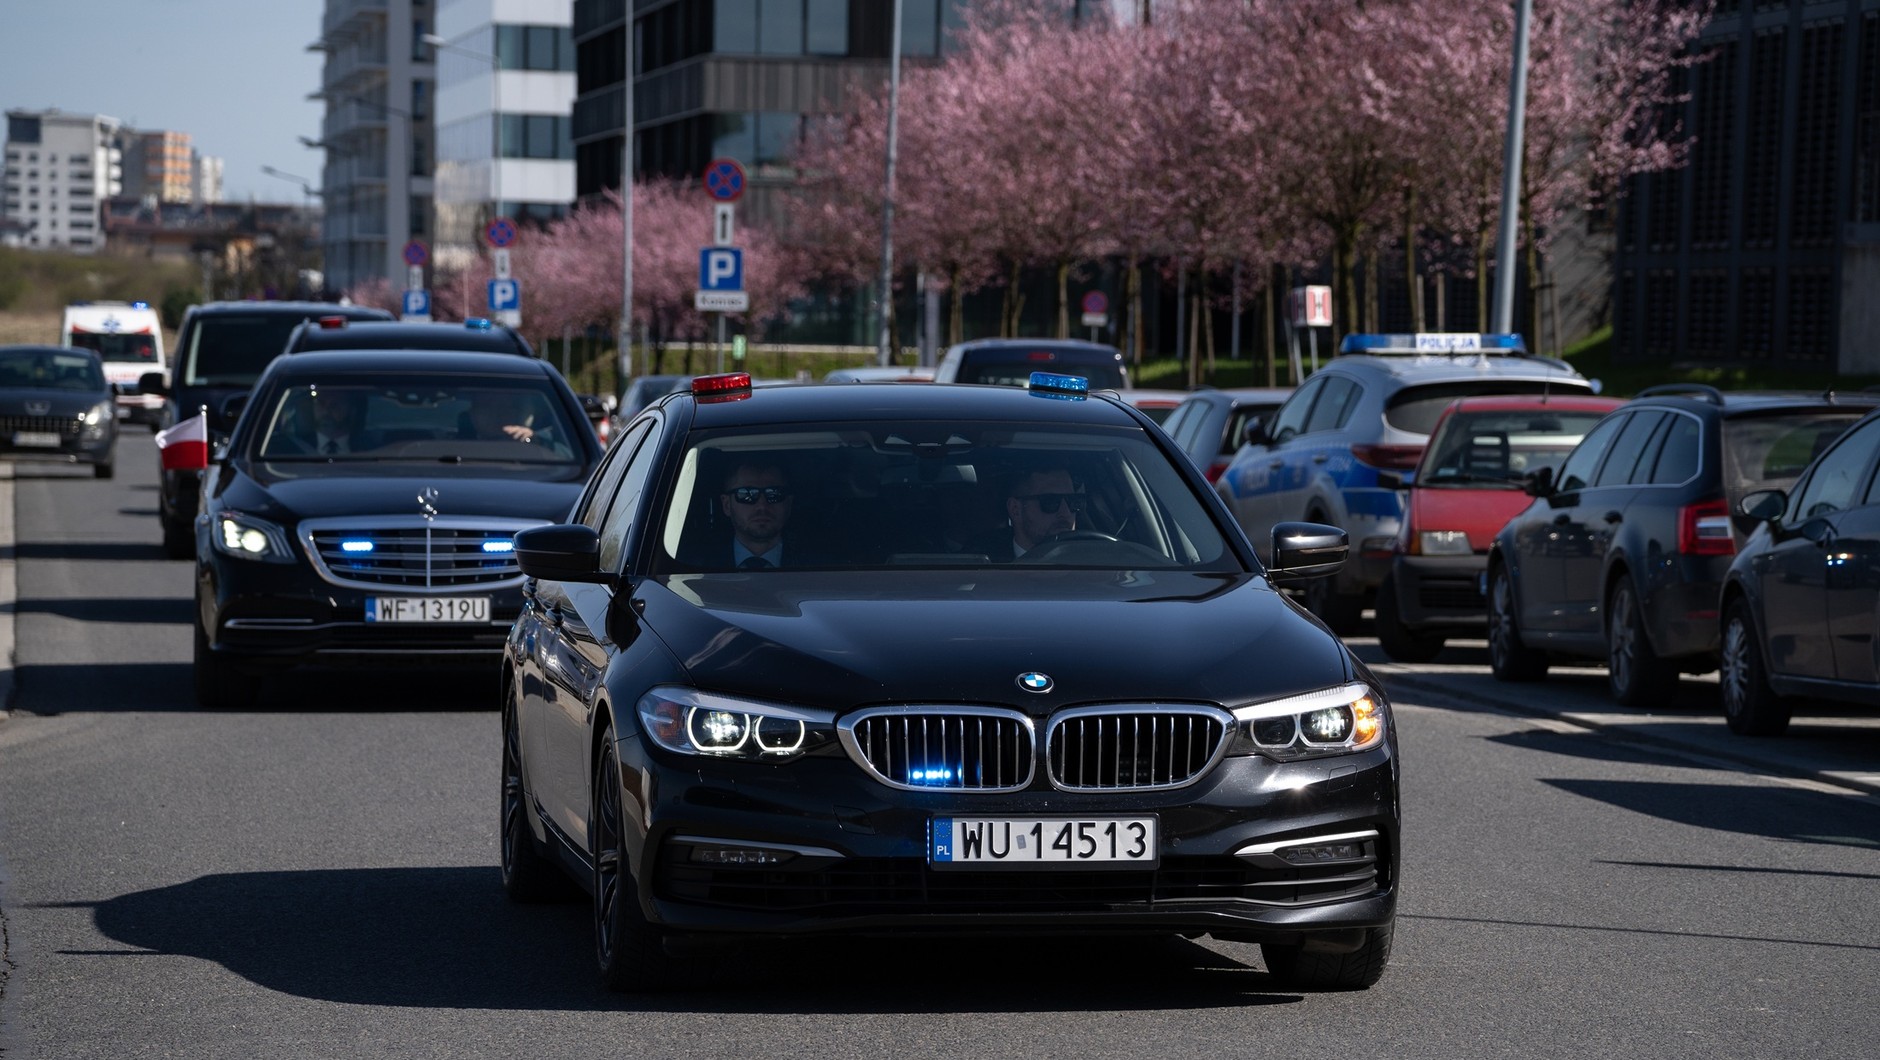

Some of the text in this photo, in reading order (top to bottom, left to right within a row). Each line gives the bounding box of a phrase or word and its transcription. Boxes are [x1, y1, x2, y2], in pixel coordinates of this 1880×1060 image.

[708, 251, 737, 288] P
[407, 291, 427, 314] P
[494, 281, 516, 309] P
[1420, 337, 1475, 348] POLICJA
[381, 599, 485, 620] WF 1319U
[936, 821, 1147, 859] PL WU 14513
